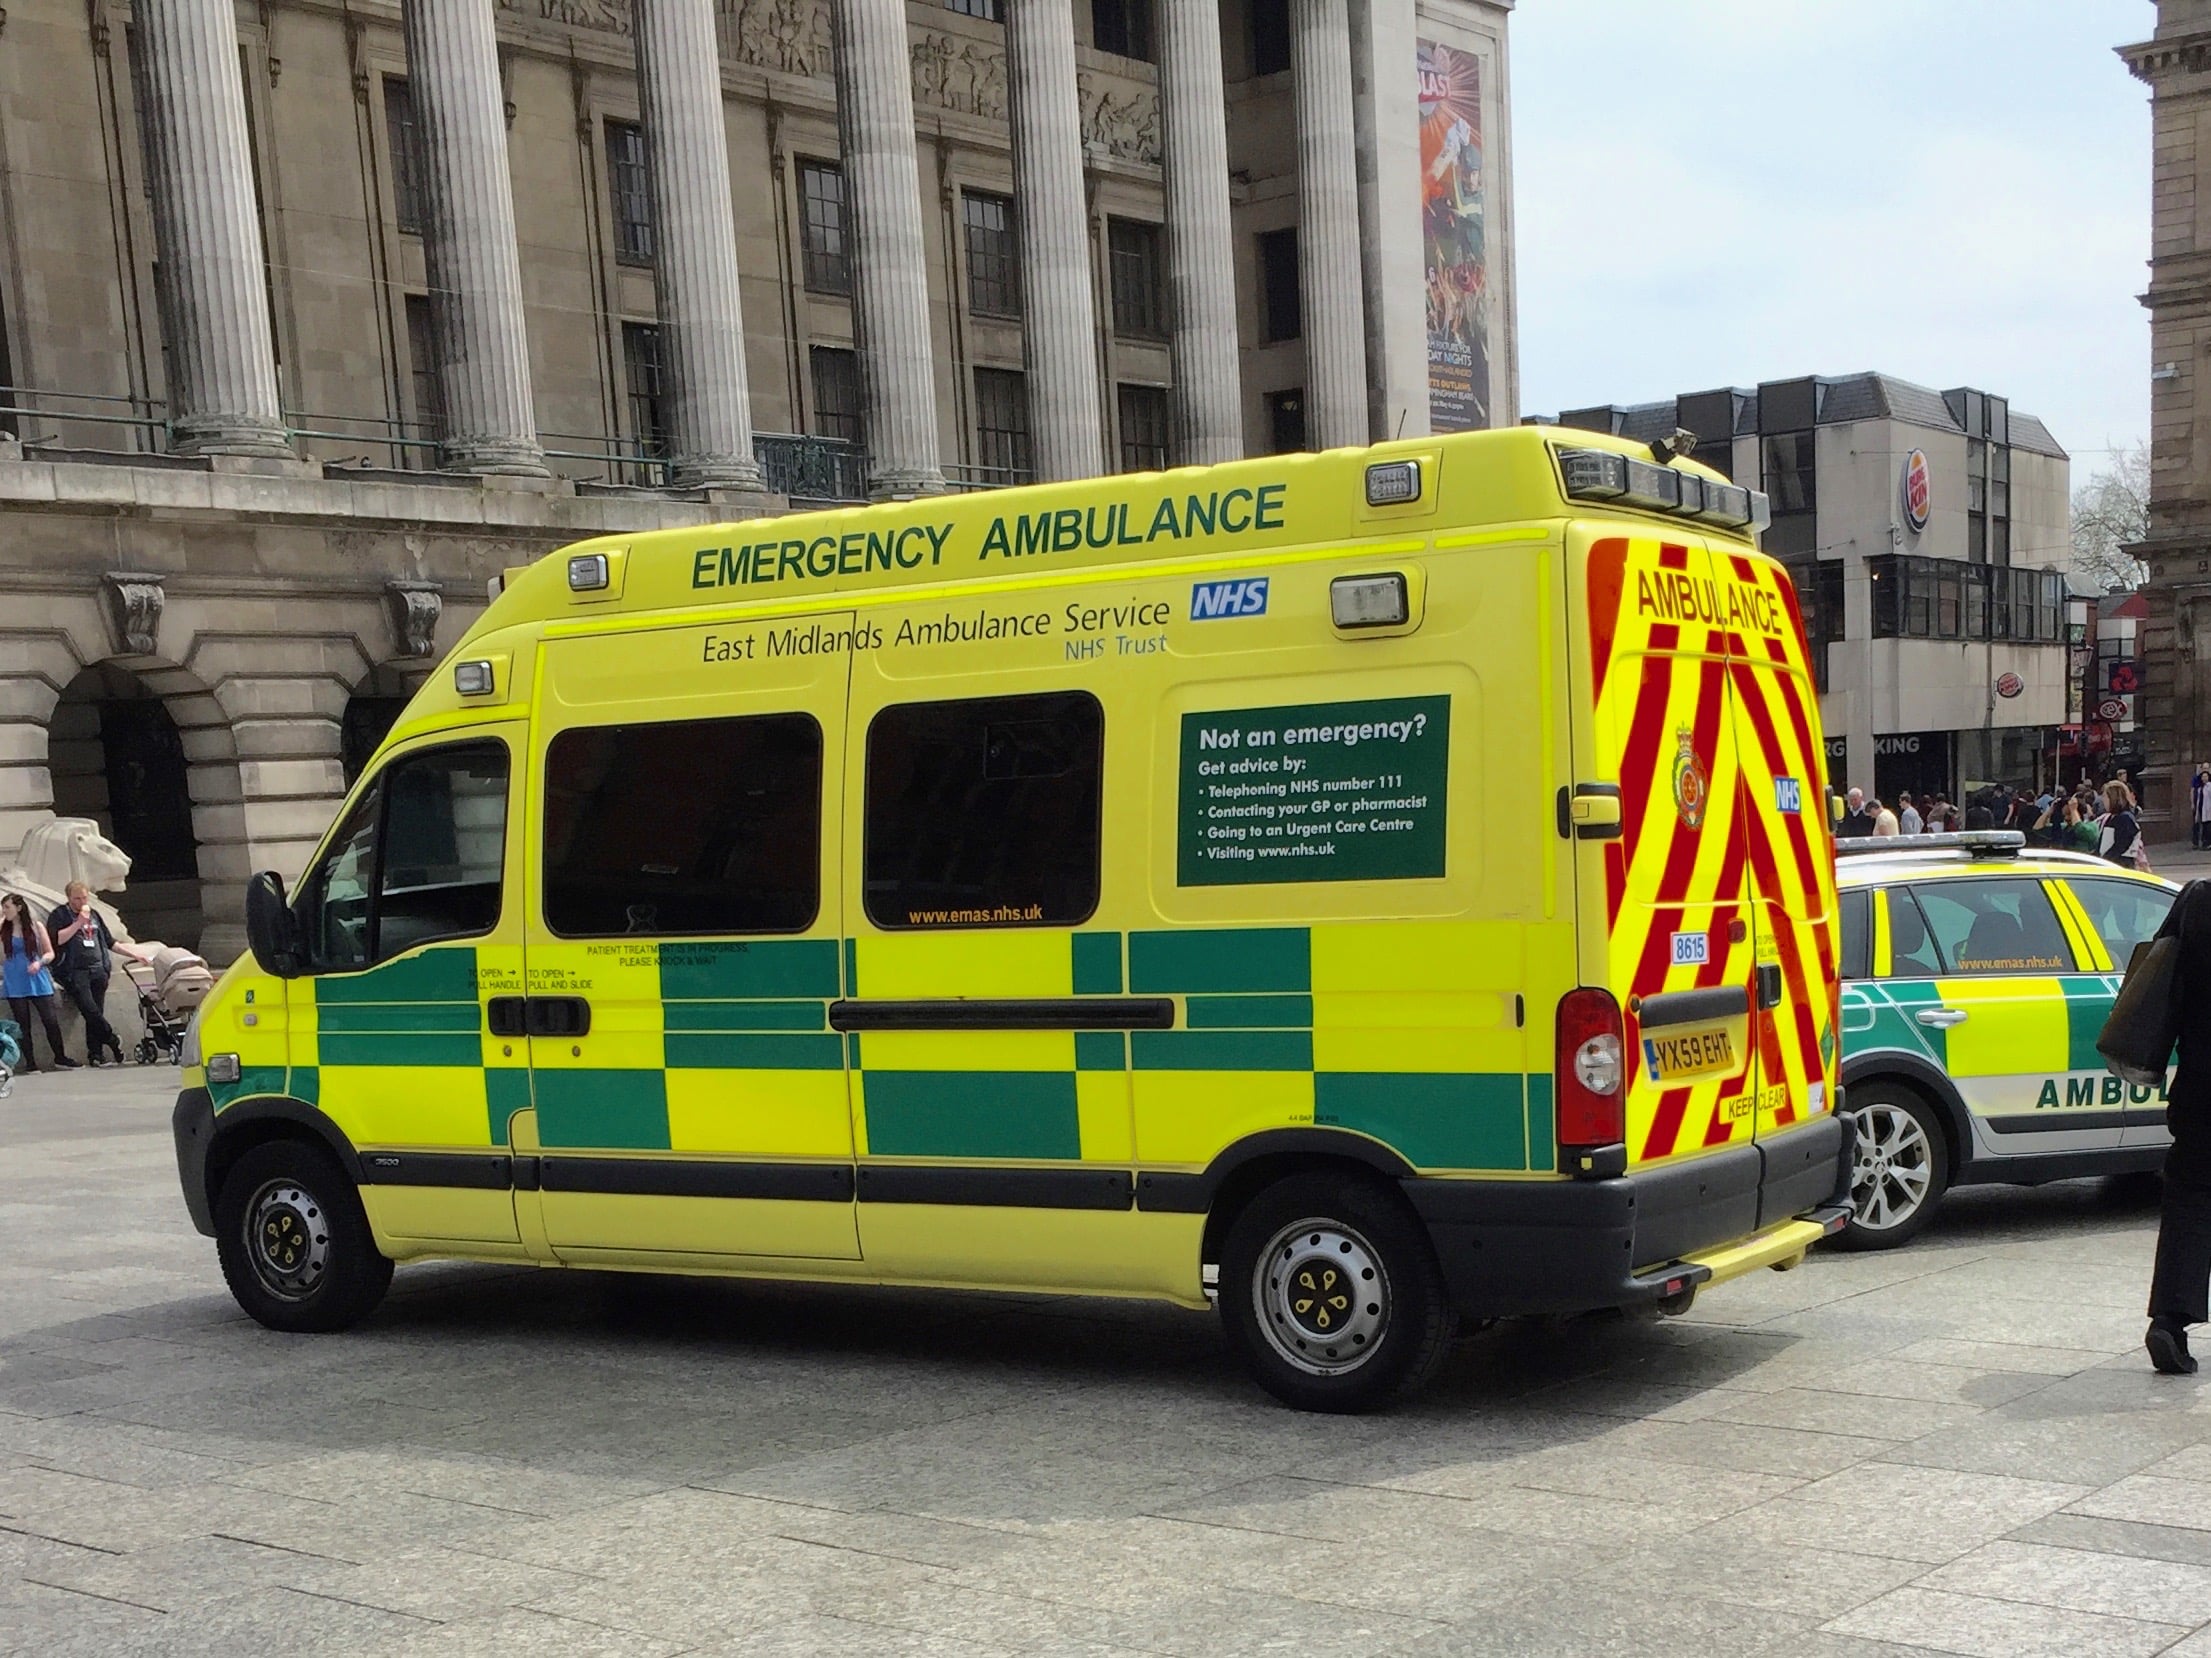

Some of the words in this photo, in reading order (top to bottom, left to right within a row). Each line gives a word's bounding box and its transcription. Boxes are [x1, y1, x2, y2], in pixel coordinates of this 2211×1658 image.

[691, 523, 954, 589] EMERGENCY
[979, 484, 1287, 560] AMBULANCE
[1193, 579, 1267, 618] NHS
[1638, 569, 1782, 635] AMBULANCE
[703, 631, 755, 663] East
[766, 620, 883, 657] Midlands
[894, 610, 1051, 648] Ambulance
[1064, 597, 1171, 633] Service
[1064, 638, 1105, 662] NHS
[1116, 632, 1169, 656] Trust
[1200, 729, 1240, 750] Not
[1247, 730, 1276, 747] an
[1283, 713, 1427, 745] emergency?
[1874, 736, 1920, 754] KING
[1199, 761, 1226, 776] Get
[1229, 758, 1278, 774] advice
[1283, 756, 1307, 774] by:
[1209, 783, 1286, 799] Telephoning
[1290, 780, 1319, 794] NHS
[1323, 776, 1375, 791] number
[1379, 775, 1402, 788] 111
[1775, 779, 1800, 811] NHS
[1208, 804, 1275, 818] Contacting
[1278, 804, 1308, 819] your
[1311, 800, 1331, 813] GP
[1334, 802, 1348, 812] or
[1352, 796, 1427, 814] pharmacist
[1208, 826, 1246, 840] Going
[1250, 826, 1262, 837] to
[1266, 826, 1283, 836] an
[1286, 823, 1332, 838] Urgent
[1335, 820, 1366, 833] Care
[1370, 818, 1414, 831] Centre
[1207, 846, 1254, 860] Visiting
[1258, 842, 1335, 857] www.nhs.uk
[909, 904, 1043, 924] www.emas.nhs.uk
[587, 946, 622, 955] PATIENT
[1677, 934, 1705, 959] 8615
[620, 958, 651, 966] PLEASE
[1958, 955, 2063, 970] www.emas.nhs.uk
[481, 969, 503, 978] OPEN
[528, 969, 539, 978] TO
[542, 969, 564, 978] OPEN
[528, 980, 548, 989] PULL
[551, 980, 567, 989] AND
[571, 980, 592, 989] SLIDE
[490, 980, 521, 990] HANDLE
[1656, 1037, 1702, 1072] YX59
[1703, 1033, 1729, 1064] EHT
[1729, 1096, 1753, 1119] KEEP
[1758, 1088, 1785, 1112] CLEAR
